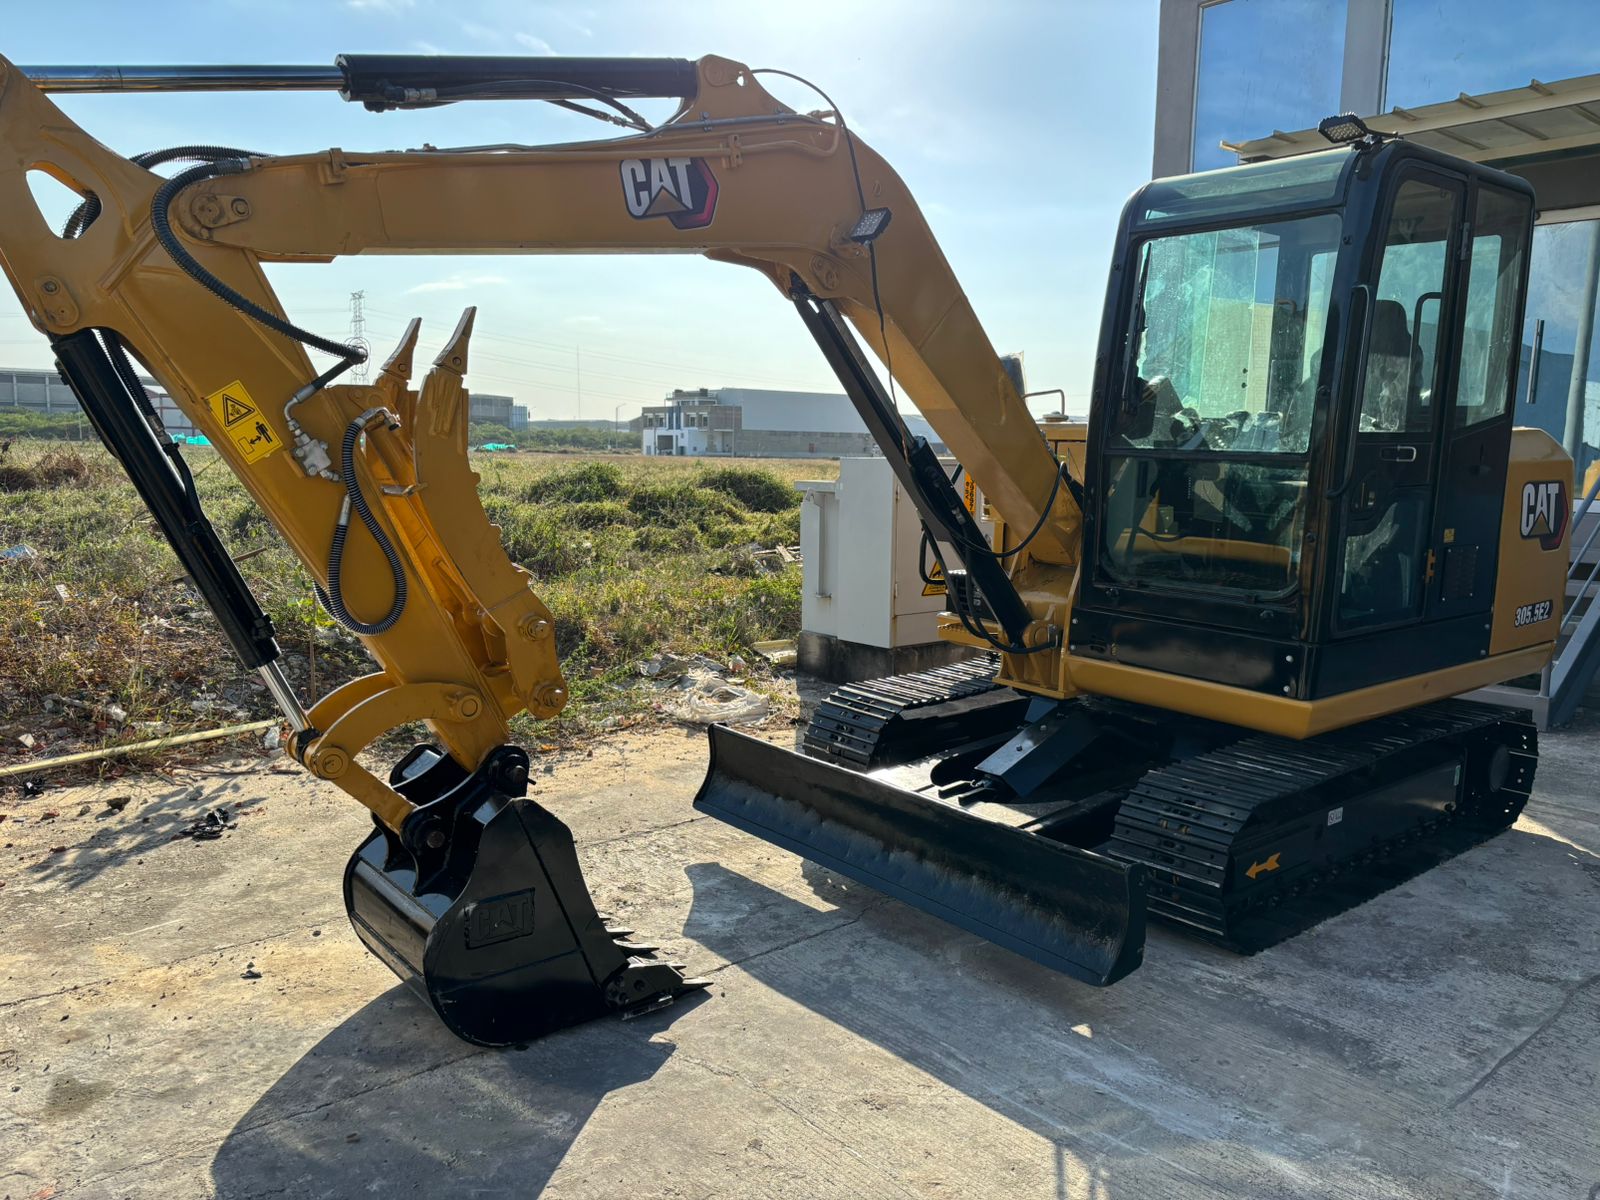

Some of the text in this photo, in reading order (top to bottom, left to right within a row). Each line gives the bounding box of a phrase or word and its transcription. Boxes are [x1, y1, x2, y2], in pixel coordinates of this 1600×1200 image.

[621, 158, 693, 216] CAT
[1521, 483, 1559, 537] CAT
[1514, 601, 1550, 626] 305.5E2
[470, 894, 529, 942] CAT
